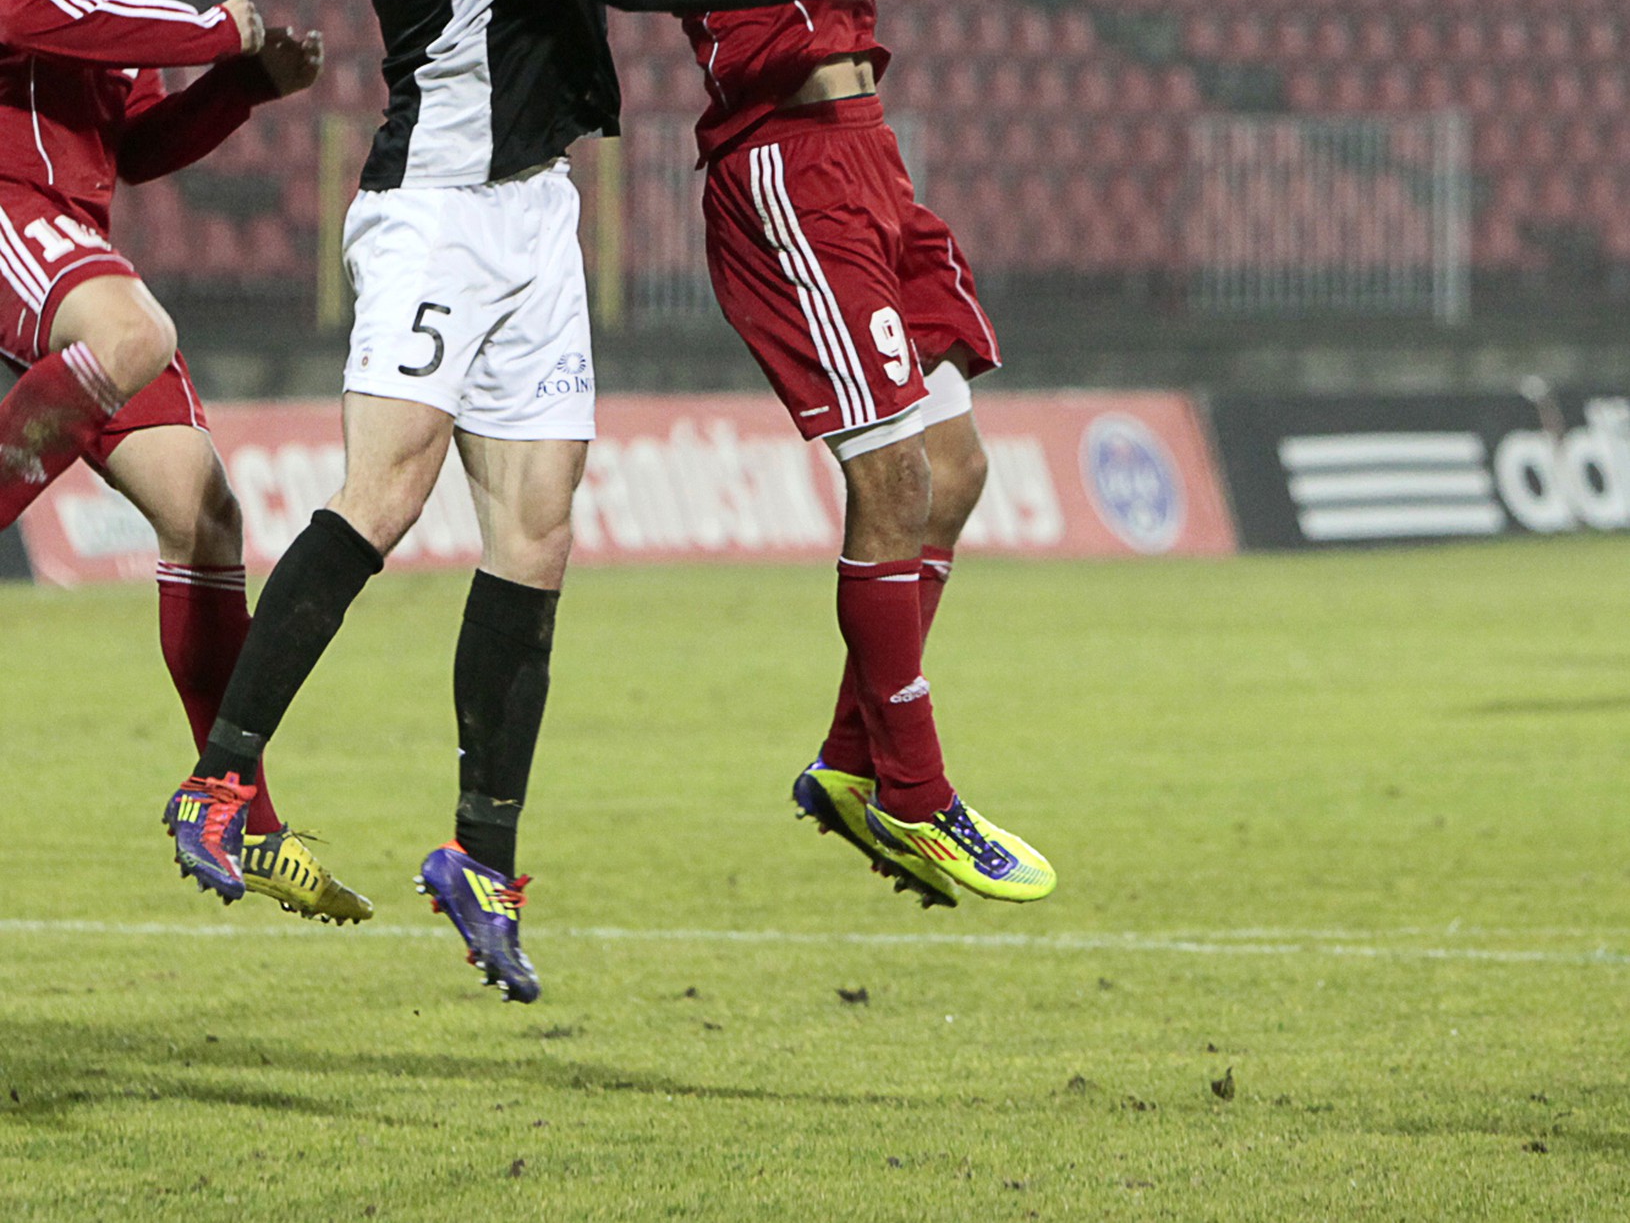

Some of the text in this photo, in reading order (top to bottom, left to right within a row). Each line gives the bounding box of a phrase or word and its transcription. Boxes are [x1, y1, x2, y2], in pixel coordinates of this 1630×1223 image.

[398, 302, 451, 377] 5
[869, 306, 911, 386] 9
[536, 379, 571, 398] ECO
